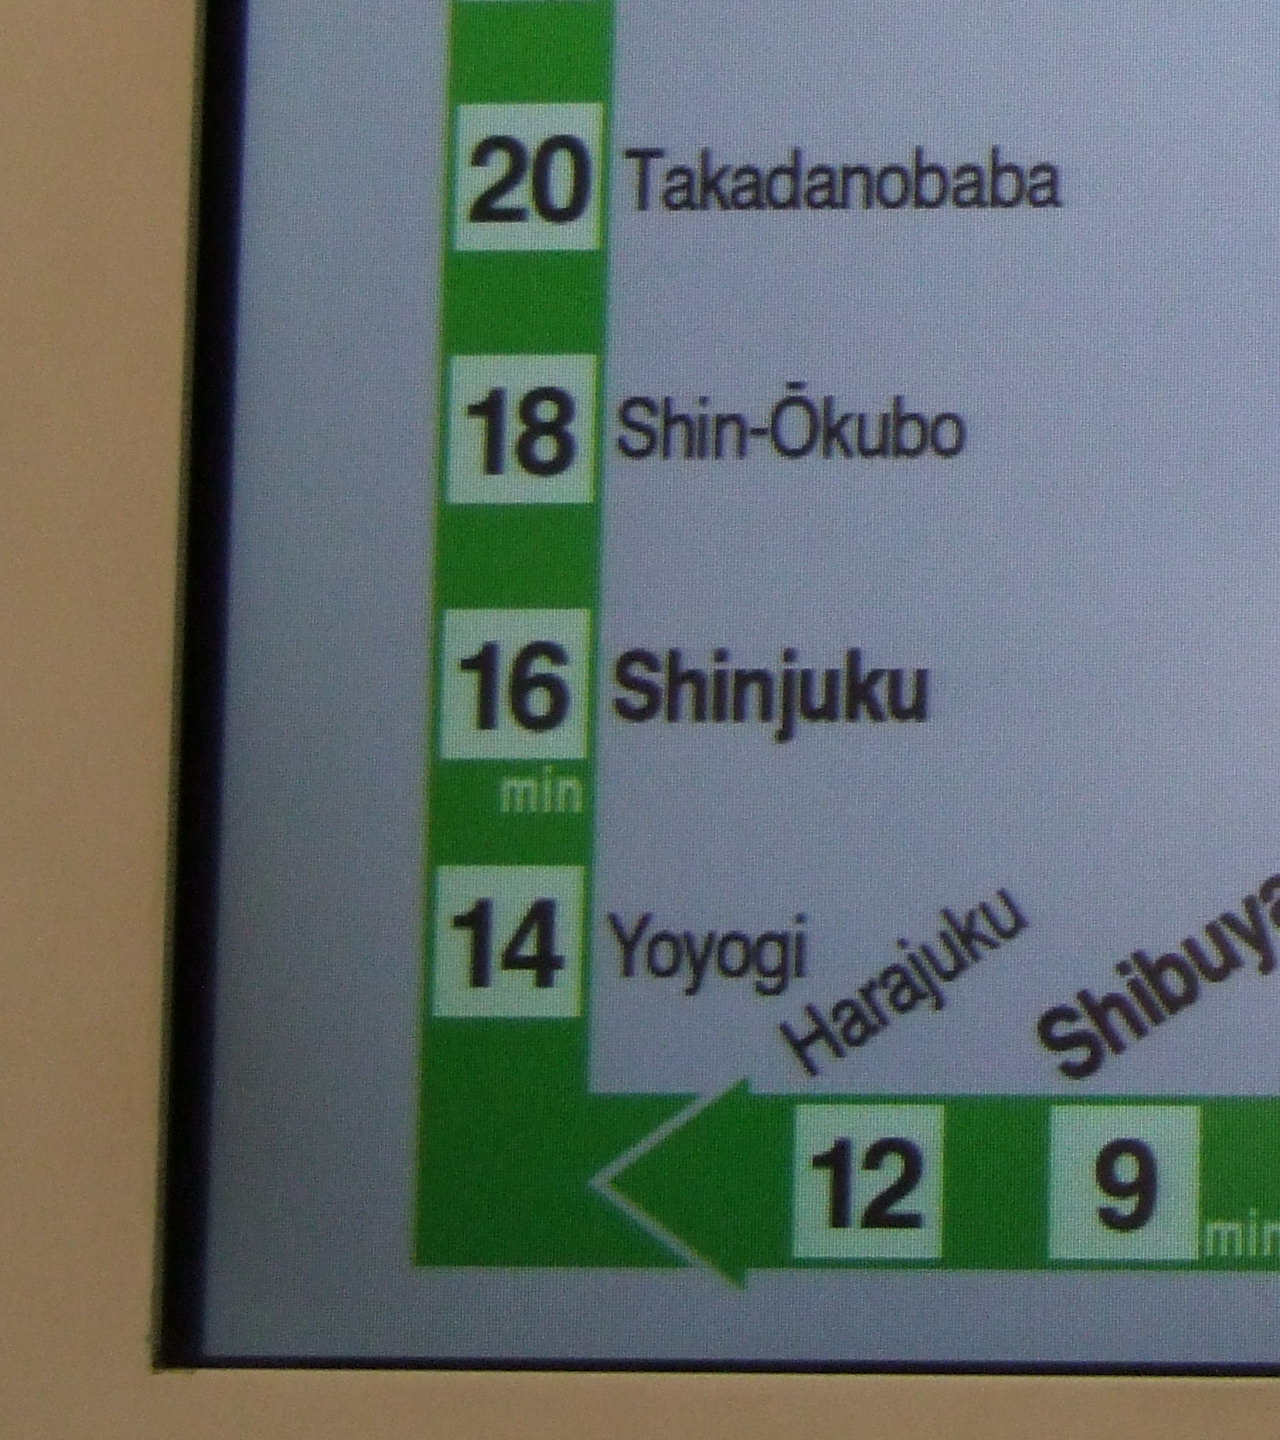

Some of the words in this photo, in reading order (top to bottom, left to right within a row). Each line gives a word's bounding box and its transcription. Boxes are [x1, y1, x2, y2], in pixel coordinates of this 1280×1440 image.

[469, 135, 591, 225] 20
[625, 147, 1061, 211] Takadanobaba
[466, 386, 577, 478] 18
[616, 381, 966, 460] Shin-Ōkubo
[458, 640, 570, 733] 16
[614, 647, 929, 744] Shinjuku
[500, 766, 582, 813] min
[451, 898, 565, 990] 14
[608, 912, 806, 994] Yoyogi
[780, 884, 1030, 1077] Harajuku
[811, 1138, 924, 1231] 12
[1095, 1138, 1158, 1233] 9
